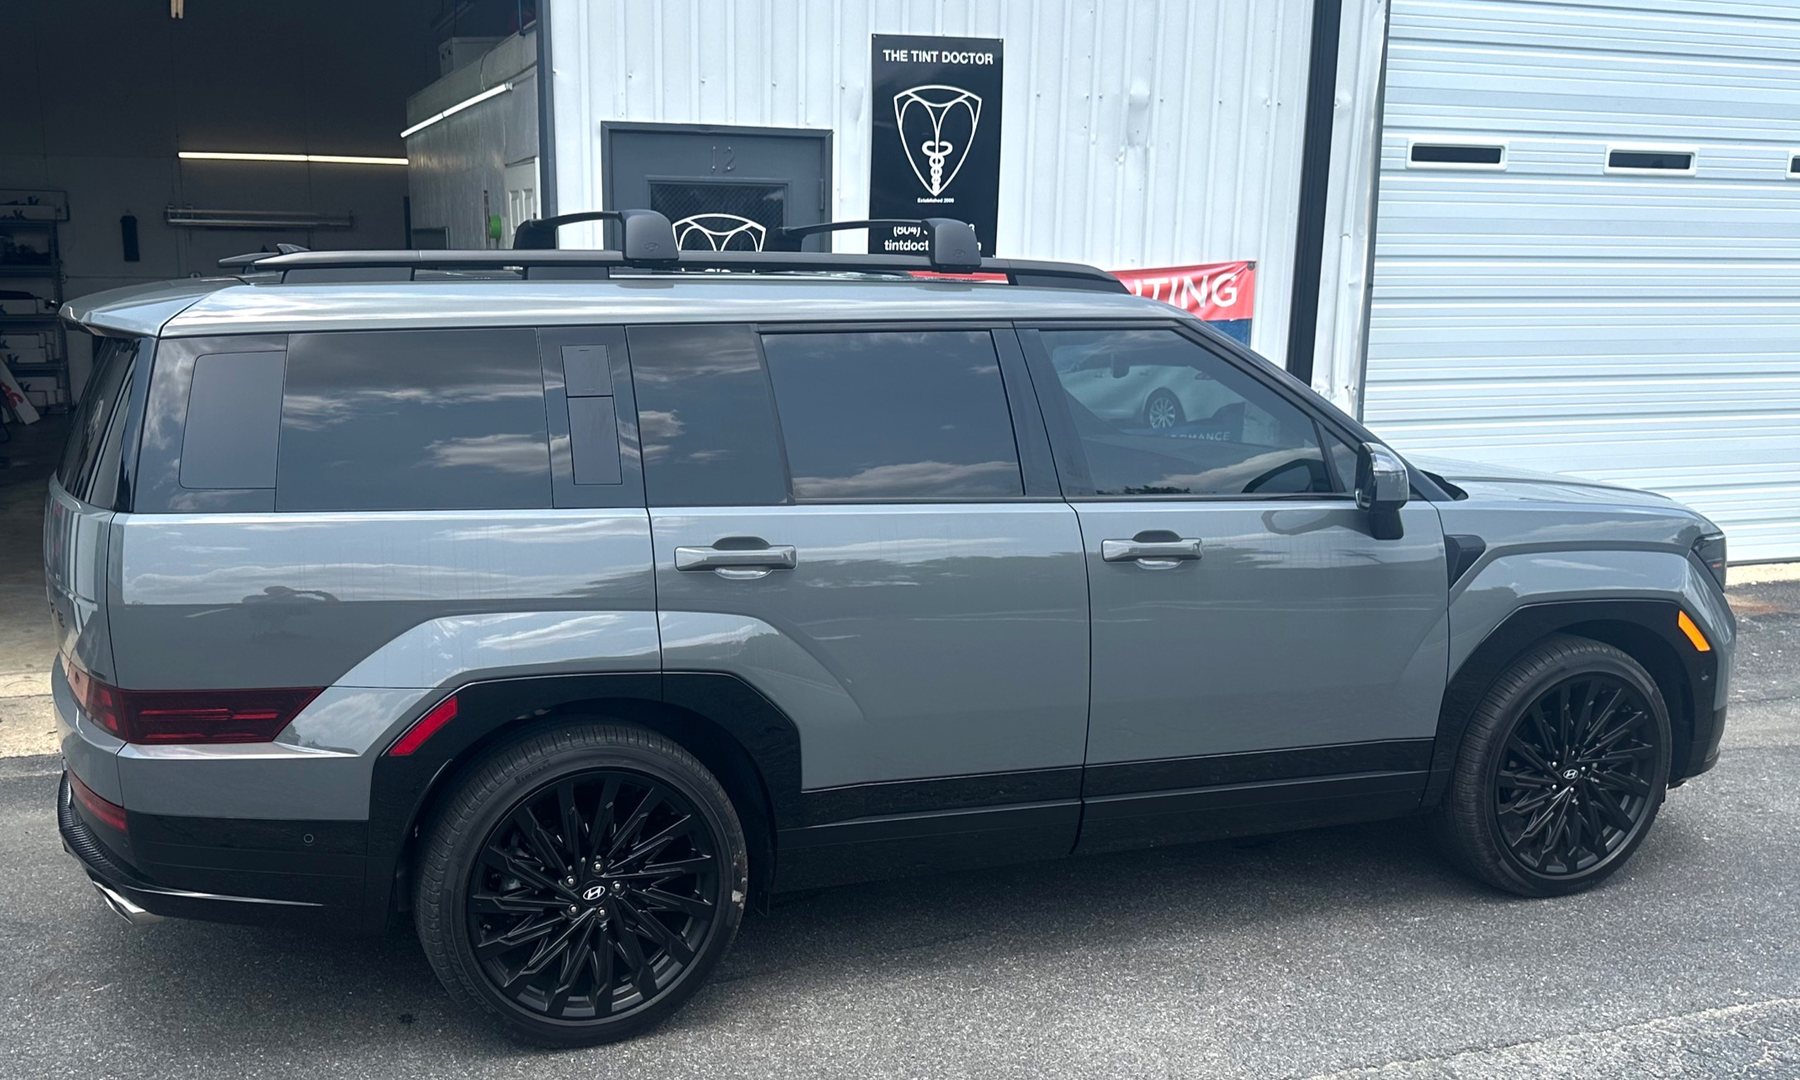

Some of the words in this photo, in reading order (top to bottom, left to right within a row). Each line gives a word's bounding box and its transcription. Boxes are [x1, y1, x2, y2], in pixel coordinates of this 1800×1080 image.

[882, 49, 908, 62] THE
[910, 50, 939, 63] TINT
[941, 51, 994, 65] DOCTOR
[884, 239, 929, 251] tintdoct
[1132, 271, 1238, 309] TING
